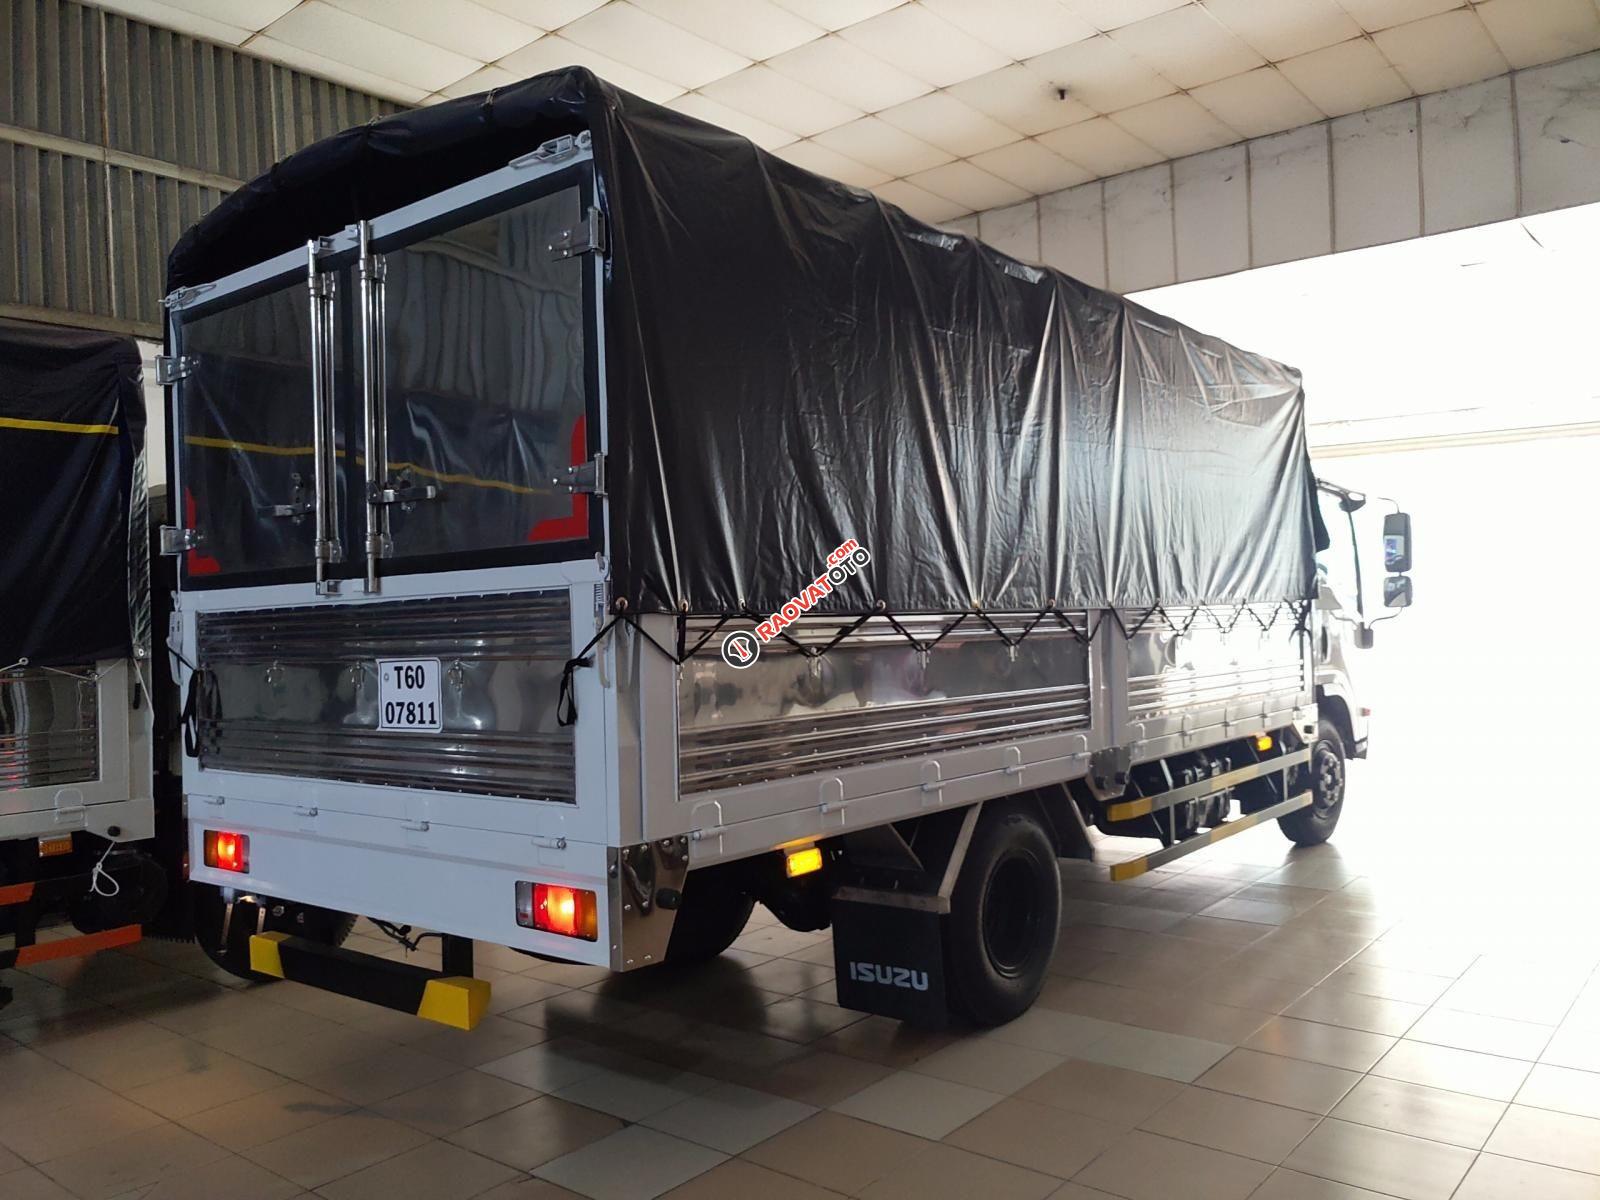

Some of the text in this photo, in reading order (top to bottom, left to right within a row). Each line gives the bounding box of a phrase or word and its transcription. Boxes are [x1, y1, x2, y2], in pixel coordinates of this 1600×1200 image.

[394, 665, 425, 689] T60
[385, 701, 437, 724] 07811
[849, 961, 929, 991] ISUZU
